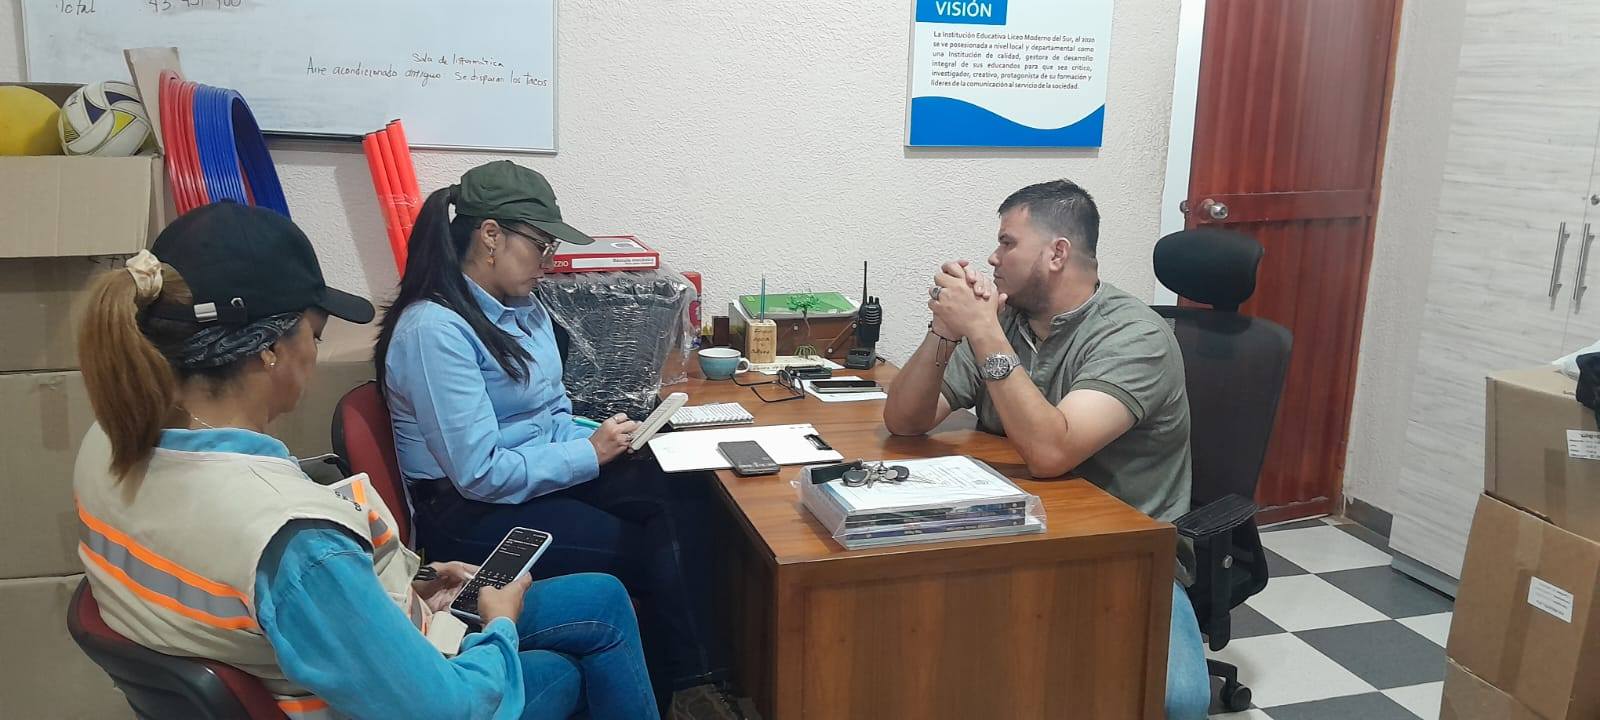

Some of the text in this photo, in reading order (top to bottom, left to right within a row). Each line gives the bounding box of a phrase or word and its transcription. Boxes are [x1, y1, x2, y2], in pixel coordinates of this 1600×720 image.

[935, 0, 992, 17] VISIÓN
[412, 52, 433, 63] Sala
[438, 55, 449, 65] de
[306, 56, 328, 76] Aire
[332, 61, 398, 78] acondicionado
[404, 68, 442, 87] antiguo
[454, 71, 468, 81] Se
[470, 67, 504, 84] disparan
[511, 70, 521, 84] los
